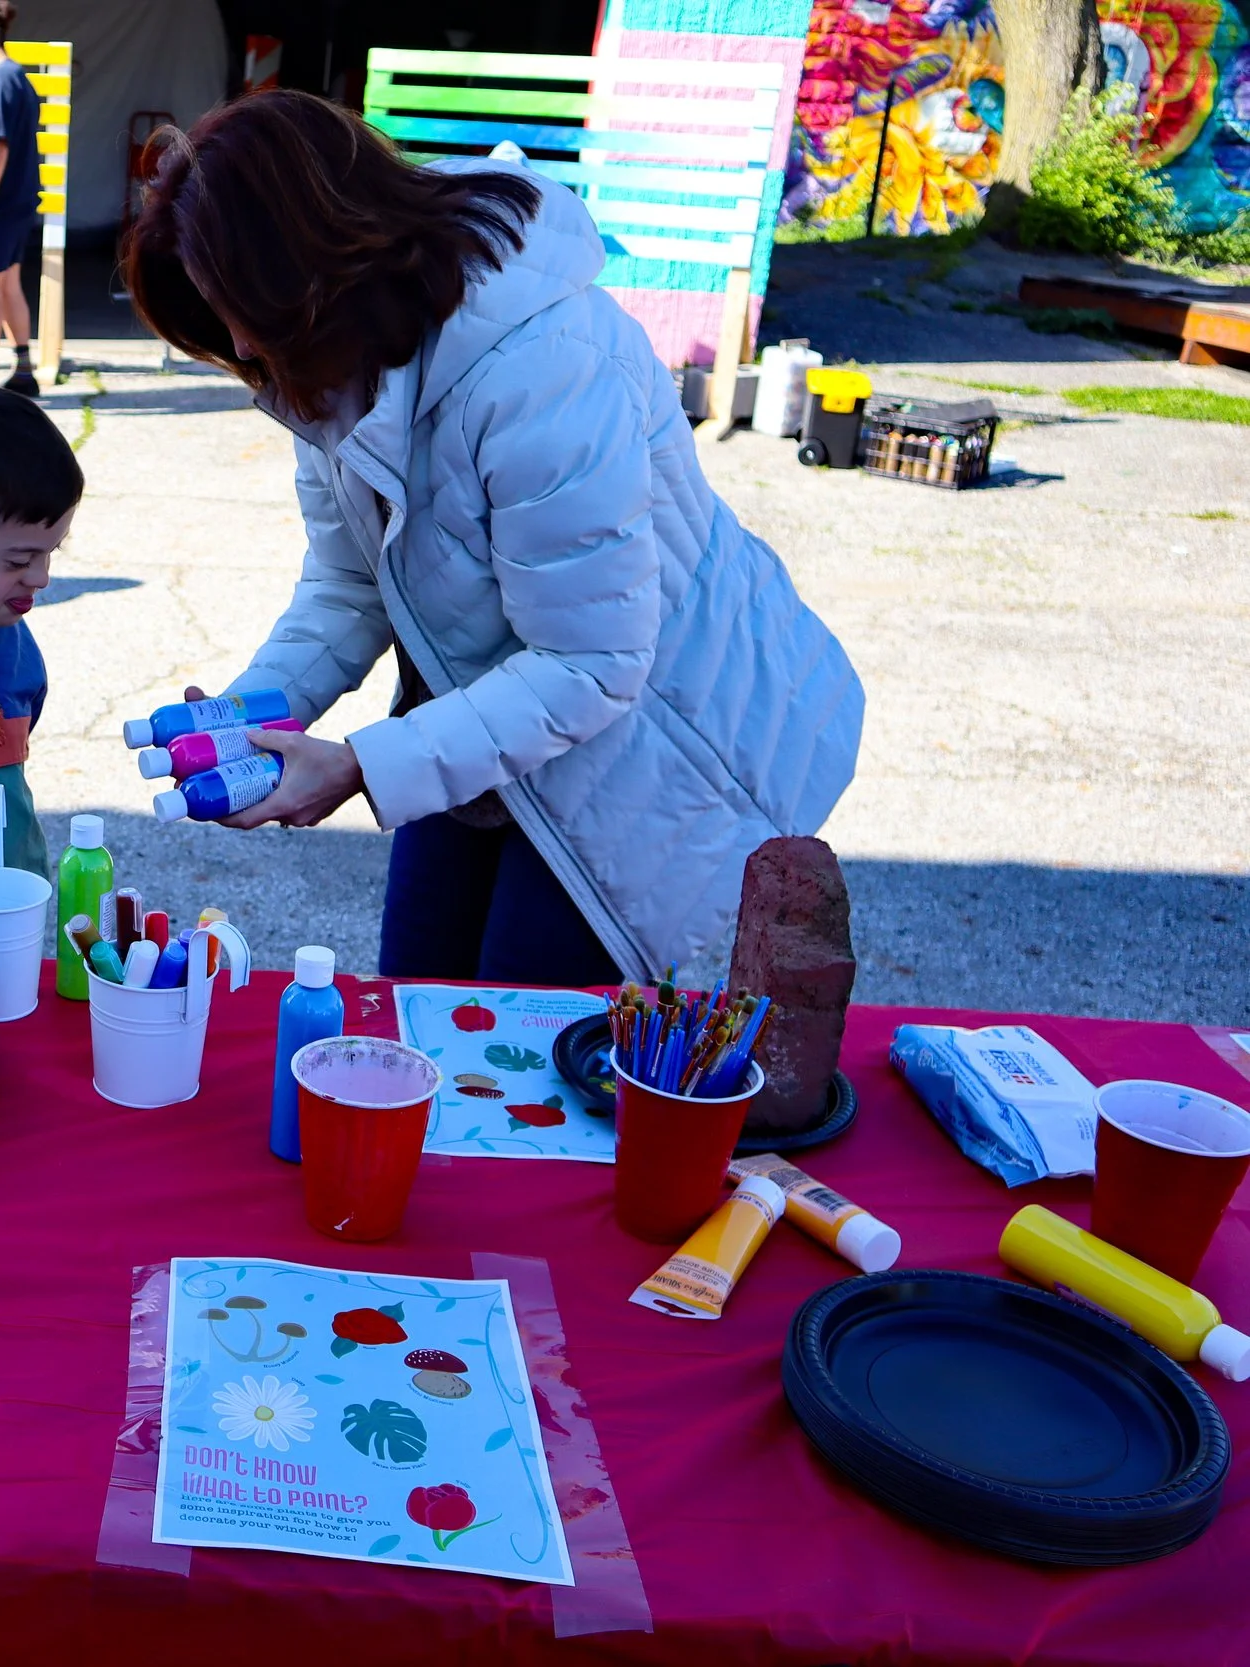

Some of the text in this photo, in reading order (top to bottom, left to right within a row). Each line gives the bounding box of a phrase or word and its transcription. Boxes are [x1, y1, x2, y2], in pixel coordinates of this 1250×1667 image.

[521, 1015, 574, 1029] AINT?
[179, 1514, 357, 1542] decorate your window box!
[180, 1503, 358, 1533] some inspiration for how to
[277, 1507, 317, 1517] plants
[321, 1511, 333, 1521] to
[336, 1515, 363, 1526] give
[367, 1519, 391, 1528] you
